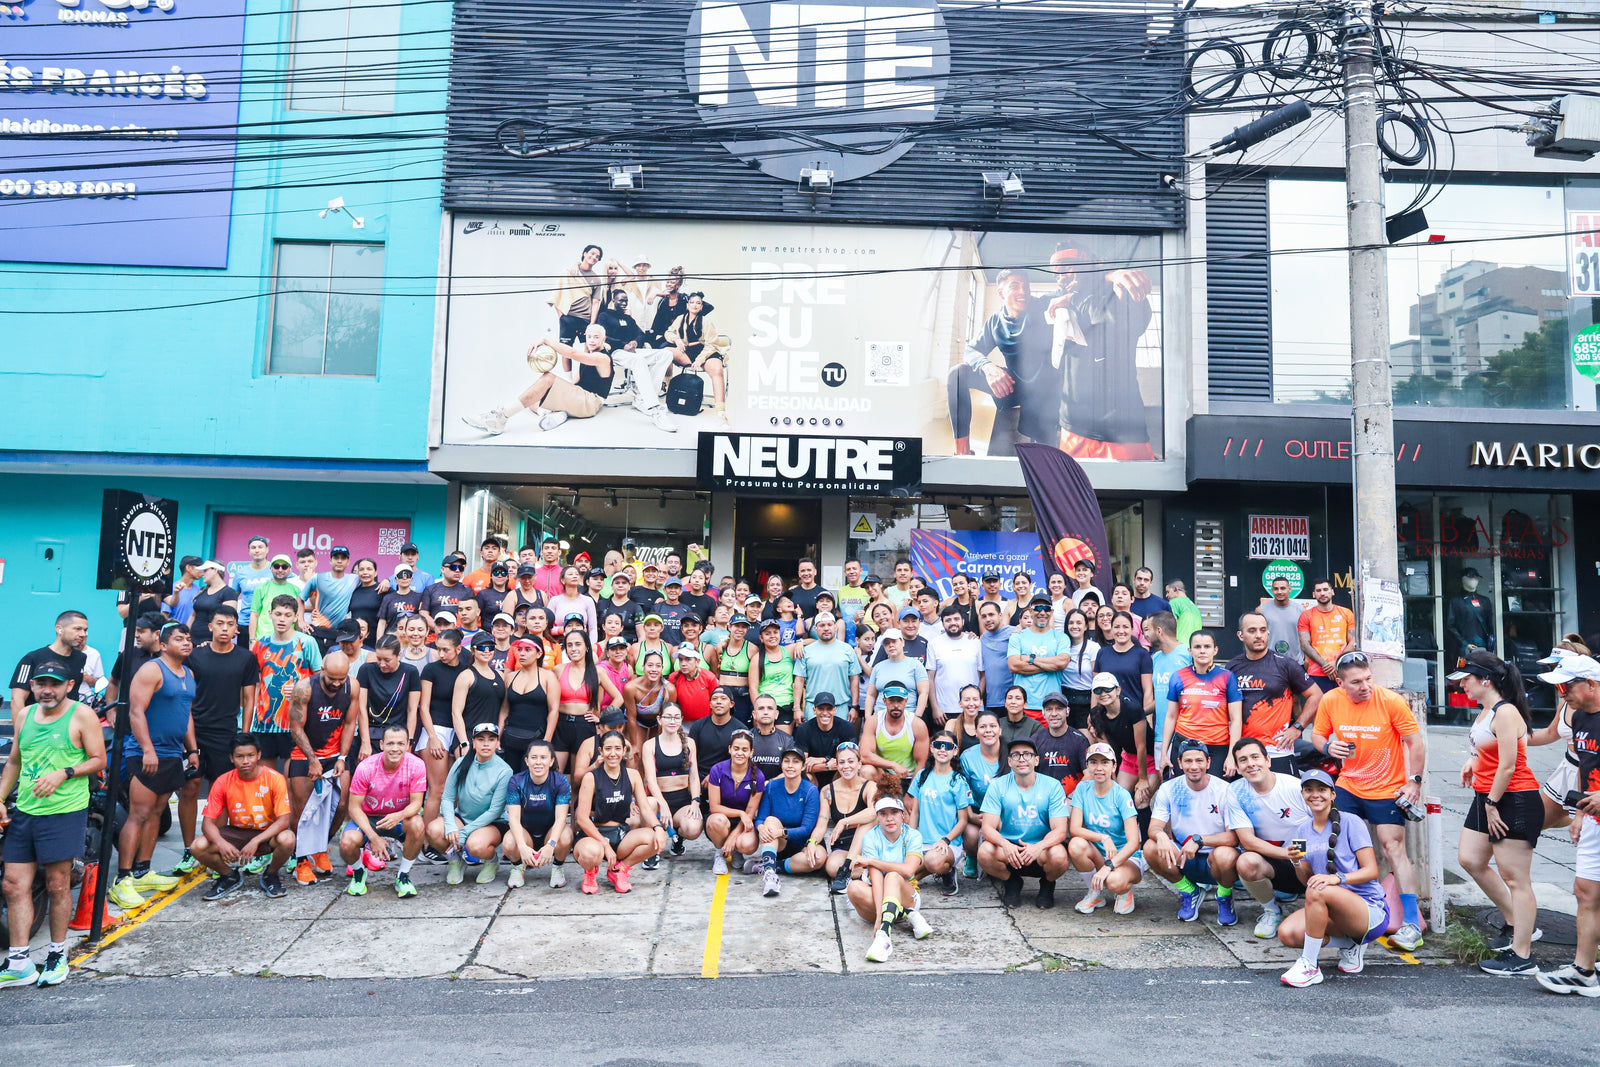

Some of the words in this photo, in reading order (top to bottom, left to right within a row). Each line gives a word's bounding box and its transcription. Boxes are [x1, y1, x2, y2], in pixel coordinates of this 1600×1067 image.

[58, 9, 129, 26] IDIOMAS
[699, 1, 935, 110] NTE
[33, 180, 78, 197] 398
[79, 182, 136, 199] 8051
[741, 245, 876, 255] www.neutreshop.com
[750, 261, 847, 305] PRE
[747, 305, 814, 348] SU
[1575, 353, 1591, 361] 300
[747, 351, 821, 393] ME
[824, 367, 846, 383] TU
[747, 395, 872, 412] PERSONALIDAD
[1285, 440, 1352, 459] OUTLE
[726, 478, 778, 488] Presume
[782, 480, 793, 488] tu
[797, 481, 879, 490] Personalidad
[121, 502, 144, 527] Neutre
[149, 502, 173, 545] Streetwear
[1251, 517, 1308, 536] ARRIENDA
[128, 528, 165, 559] NTE
[292, 527, 331, 550] ula
[1251, 537, 1268, 555] 316
[1269, 538, 1286, 555] 231
[1286, 538, 1308, 556] 0414
[963, 552, 997, 560] Atrévete
[1006, 554, 1029, 562] gozar
[1055, 543, 1095, 574] NTE
[1415, 545, 1545, 561] EXTRAORDINARIAS
[956, 561, 1027, 575] Carnaval
[1268, 564, 1298, 572] arriendo
